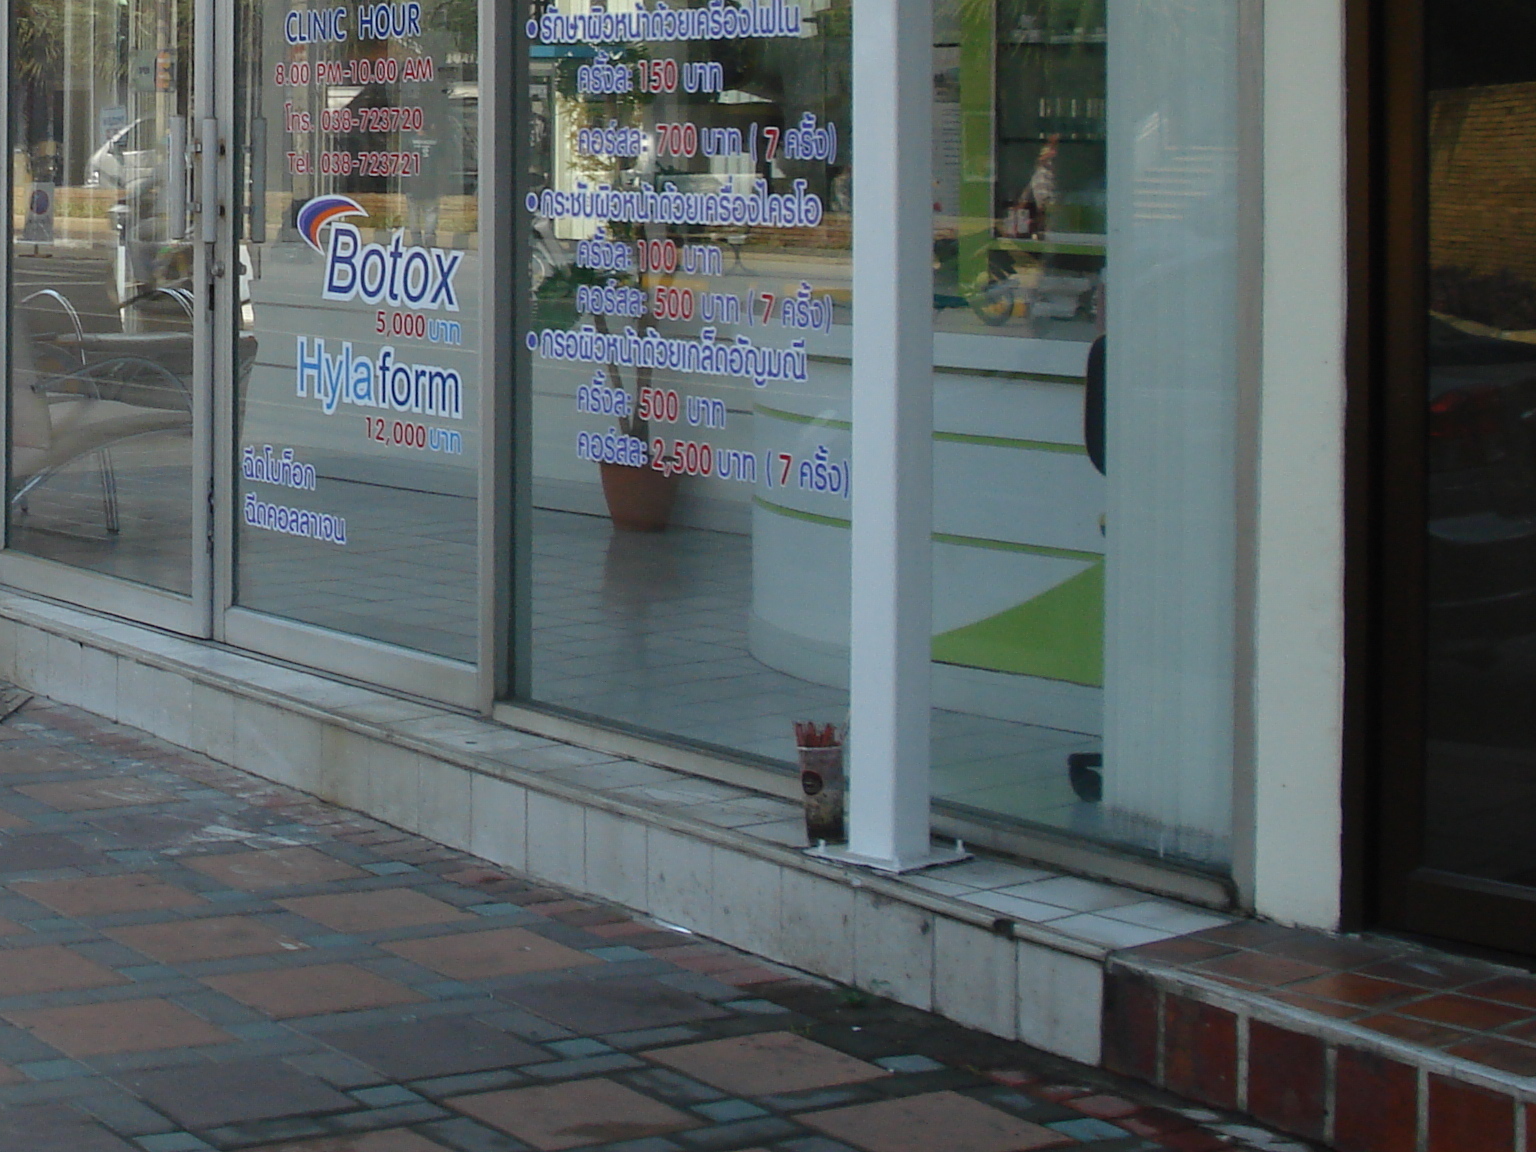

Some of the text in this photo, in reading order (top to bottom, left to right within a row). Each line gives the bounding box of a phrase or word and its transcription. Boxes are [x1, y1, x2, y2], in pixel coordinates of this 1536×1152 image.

[284, 2, 421, 45] CLINIC HOUR
[274, 61, 311, 86] 8.00
[316, 57, 398, 85] PM-10.00
[403, 56, 434, 83] AM
[638, 59, 678, 94] 150
[683, 61, 724, 94] บาท
[320, 106, 424, 133] 038-723720
[655, 122, 698, 157] 700
[702, 125, 743, 157] บาท
[763, 127, 780, 162] 7
[287, 150, 421, 177] Tel. 038-723721
[323, 221, 464, 312] Botox
[638, 239, 677, 273] 100
[683, 244, 723, 276] บาท
[653, 287, 694, 322] 500
[700, 291, 740, 324] บาท
[761, 293, 776, 326] 7
[375, 310, 462, 345] 5,000 บาท
[297, 336, 463, 419] Hylaform
[639, 388, 680, 423] 500
[686, 396, 727, 429] บาท
[365, 415, 462, 454] 12,000 บาท
[651, 438, 714, 478] 2,500
[717, 449, 757, 483] บาท
[777, 452, 793, 487] 7
[244, 491, 347, 545] ฉีดคอลลาเจน
